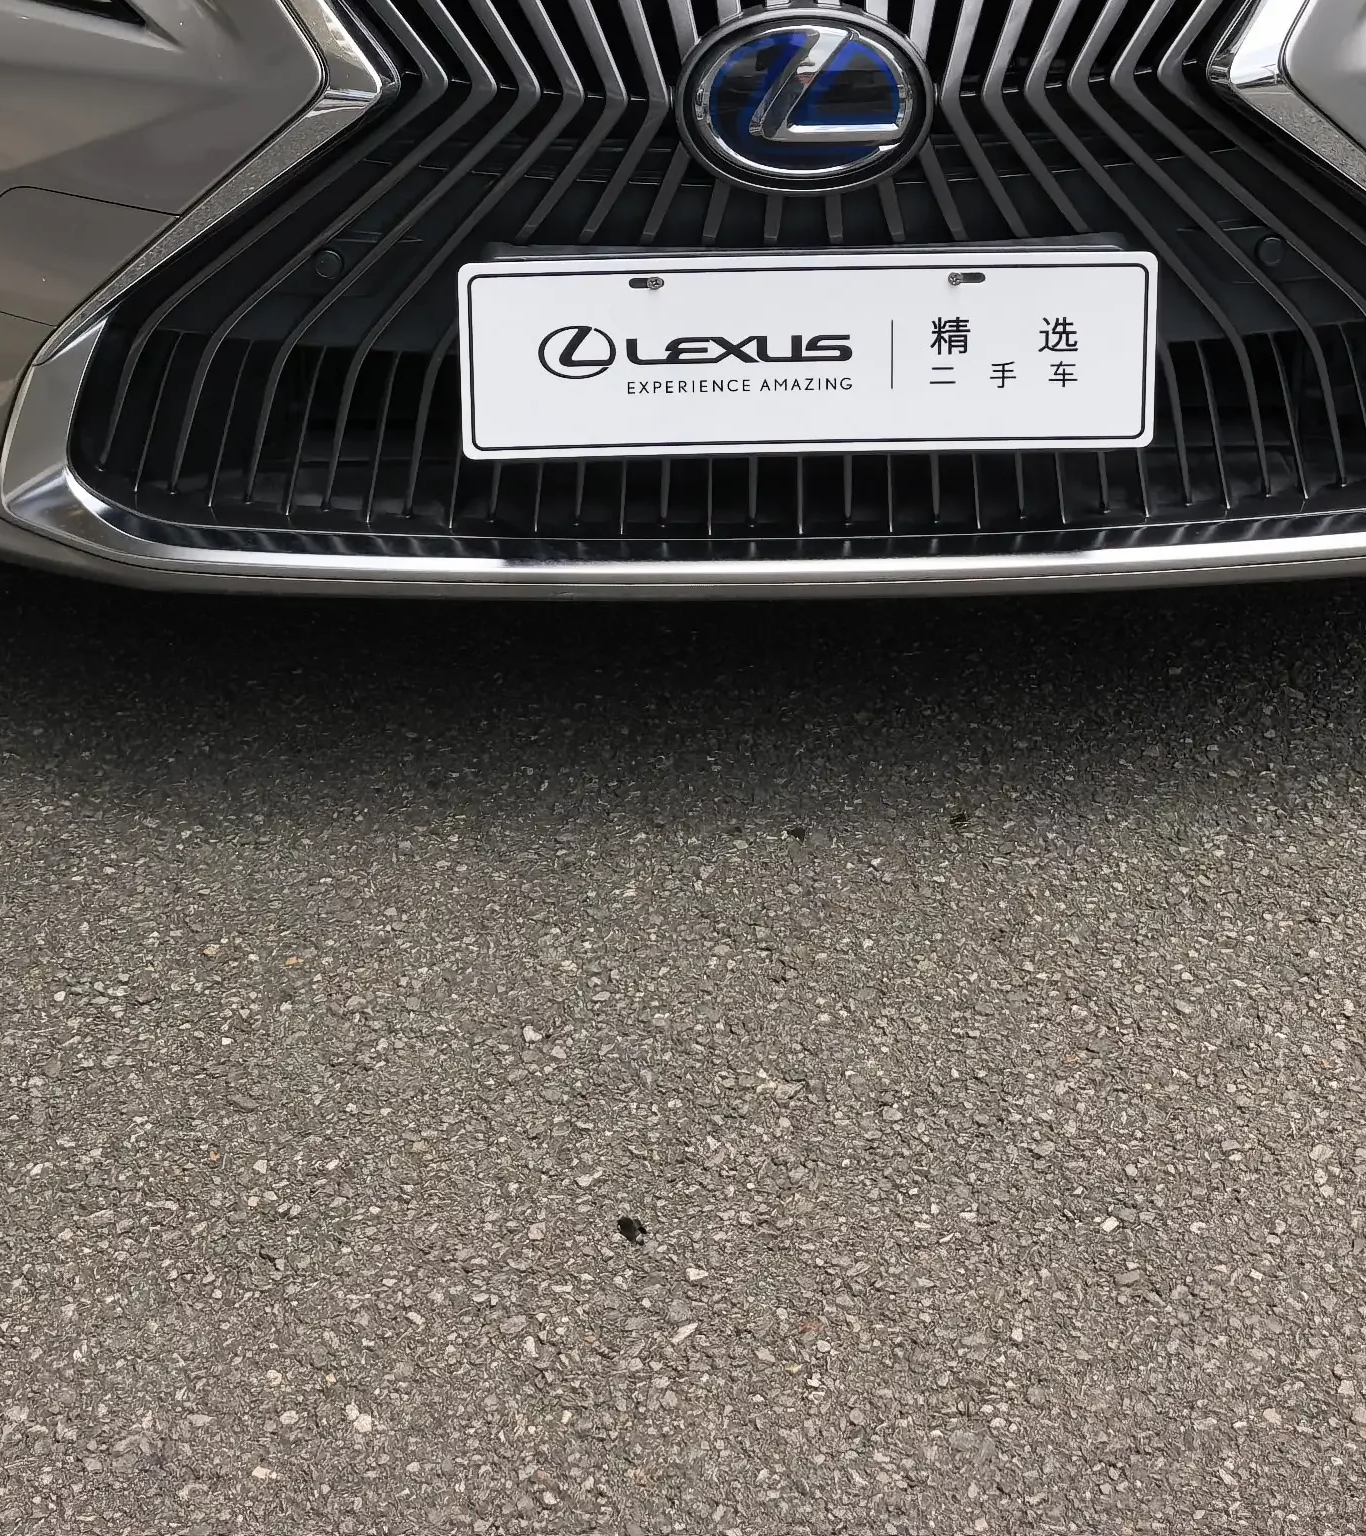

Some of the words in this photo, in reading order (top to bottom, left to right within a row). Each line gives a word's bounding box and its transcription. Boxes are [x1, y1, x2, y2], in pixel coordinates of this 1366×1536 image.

[625, 334, 853, 366] LEXUS
[627, 379, 751, 395] EXPERIENCE
[759, 377, 853, 393] AMAZING
[930, 360, 1078, 389] 二手车
